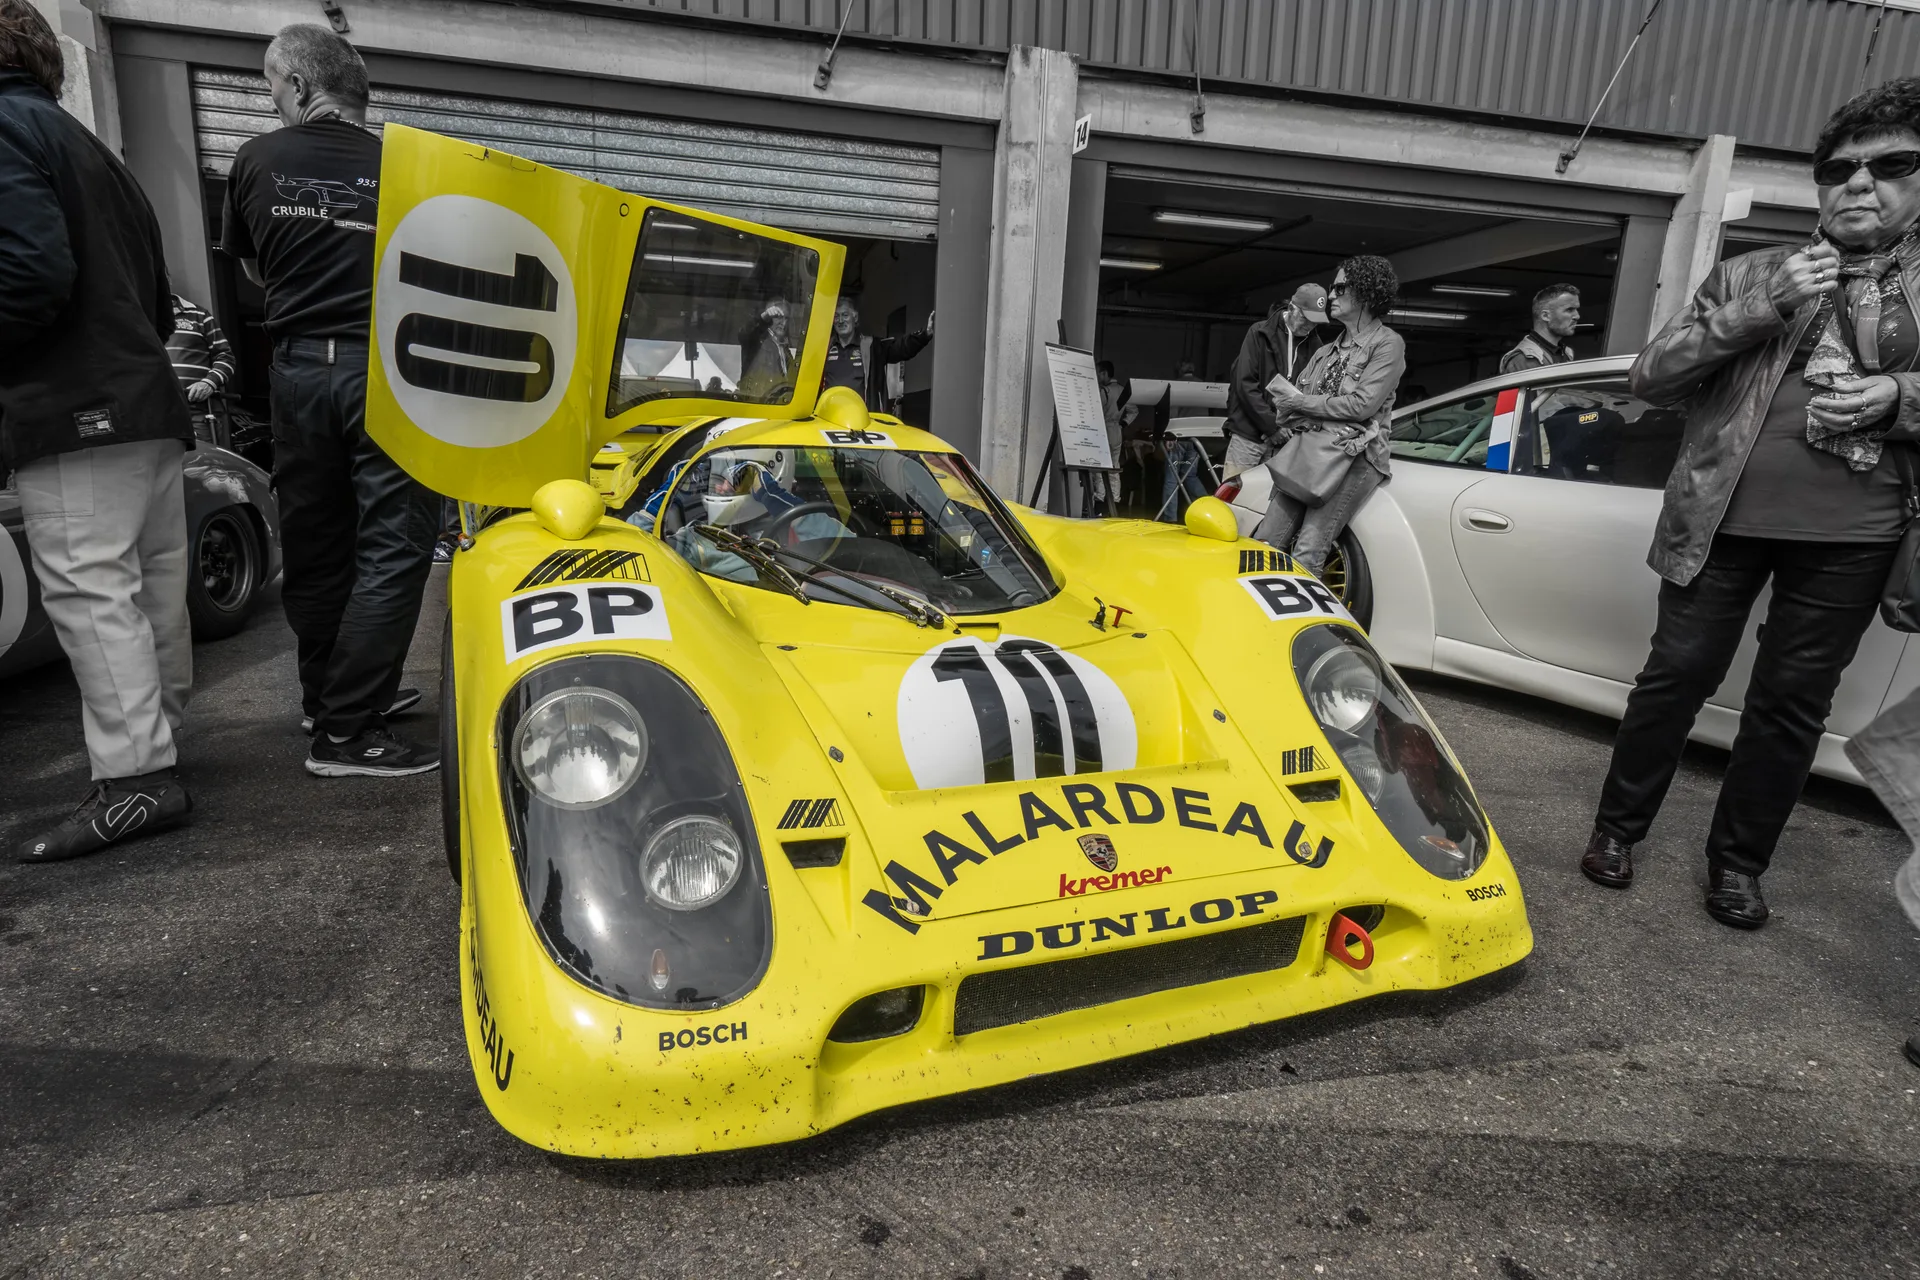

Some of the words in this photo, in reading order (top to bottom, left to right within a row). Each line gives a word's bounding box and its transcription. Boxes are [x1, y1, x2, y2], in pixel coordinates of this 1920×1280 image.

[1076, 121, 1088, 148] 14
[356, 178, 377, 187] 935
[271, 205, 328, 218] CRUBILÉ
[395, 250, 558, 403] 10
[1580, 413, 1597, 422] OMP
[825, 431, 886, 444] BP
[1248, 578, 1339, 615] BP
[512, 587, 654, 653] BP
[931, 639, 1103, 784] 10
[862, 781, 1335, 935] MALARDEAU
[1059, 866, 1172, 897] kremer
[1465, 883, 1507, 901] BOSCH
[977, 890, 1278, 961] DUNLOP
[659, 1021, 748, 1052] BOSCH
